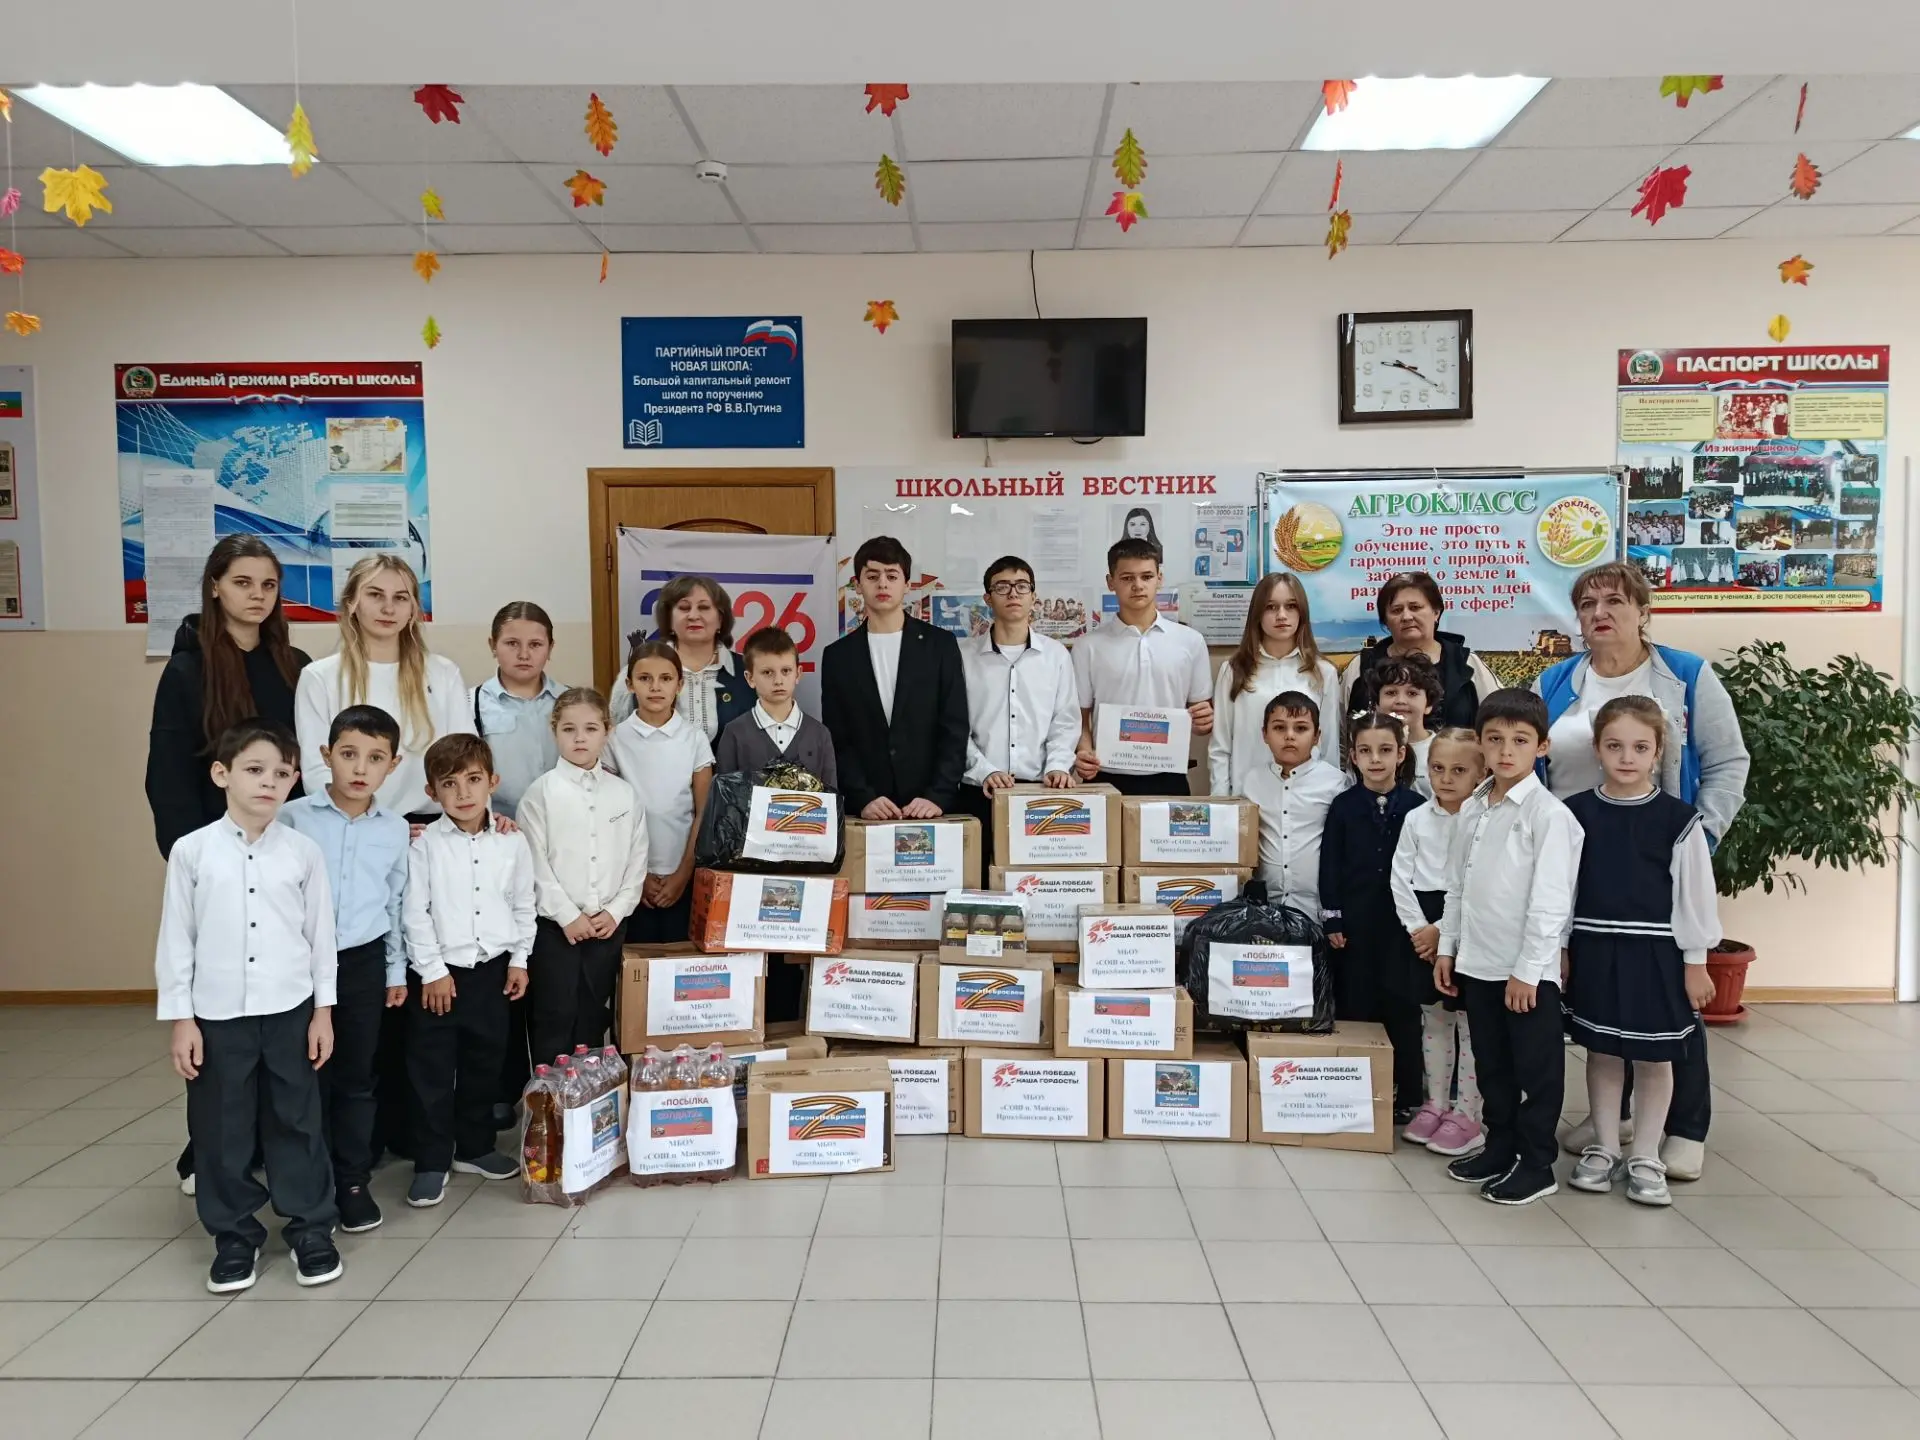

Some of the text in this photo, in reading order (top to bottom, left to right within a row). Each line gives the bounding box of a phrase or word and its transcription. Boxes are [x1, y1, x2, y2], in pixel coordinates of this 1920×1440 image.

[1379, 332, 1392, 345] 11
[1398, 330, 1412, 344] 12
[655, 345, 767, 357] ПАРТИЙНЫЙ ПРОЕКТ
[1361, 341, 1375, 354] 10
[1437, 338, 1448, 352] 2
[671, 361, 752, 371] НОВАЯ ШКОЛА:
[1363, 362, 1373, 375] 9
[1436, 359, 1447, 373] 3
[1677, 354, 1879, 373] ПАСПОРТ ШКОЛЫ
[160, 373, 416, 388] Единый режим работы школы
[633, 375, 791, 387] Большой капитальный ремонт
[1363, 384, 1373, 397] 8
[1436, 381, 1447, 396] 4
[662, 391, 763, 402] школ по поручению
[1382, 390, 1393, 404] 7
[1400, 390, 1411, 403] 6
[1419, 389, 1428, 402] 5
[644, 403, 782, 415] Президента РФ В.В.Путина
[1705, 444, 1719, 452] Из
[895, 471, 1217, 497] ШКОЛЬНЫЙ ВЕСТНИК
[1348, 490, 1537, 516] АГРОКЛАСС
[1548, 500, 1601, 519] АГРОКЛАСС
[1381, 524, 1500, 537] Это не просто
[1354, 539, 1526, 554] обучение, это путь к
[1350, 552, 1530, 569] гармонии с природой,
[1366, 568, 1516, 582] забо о земле и
[1493, 582, 1531, 594] идей
[1366, 602, 1375, 611] в
[1460, 596, 1514, 612] сфере!
[1129, 711, 1167, 719] «ПОСЫЛКА
[1242, 952, 1285, 960] «ПОСЫЛКА
[684, 964, 727, 972] «ПОСЫЛКА
[661, 1097, 709, 1105] «ПОСЫЛКА
